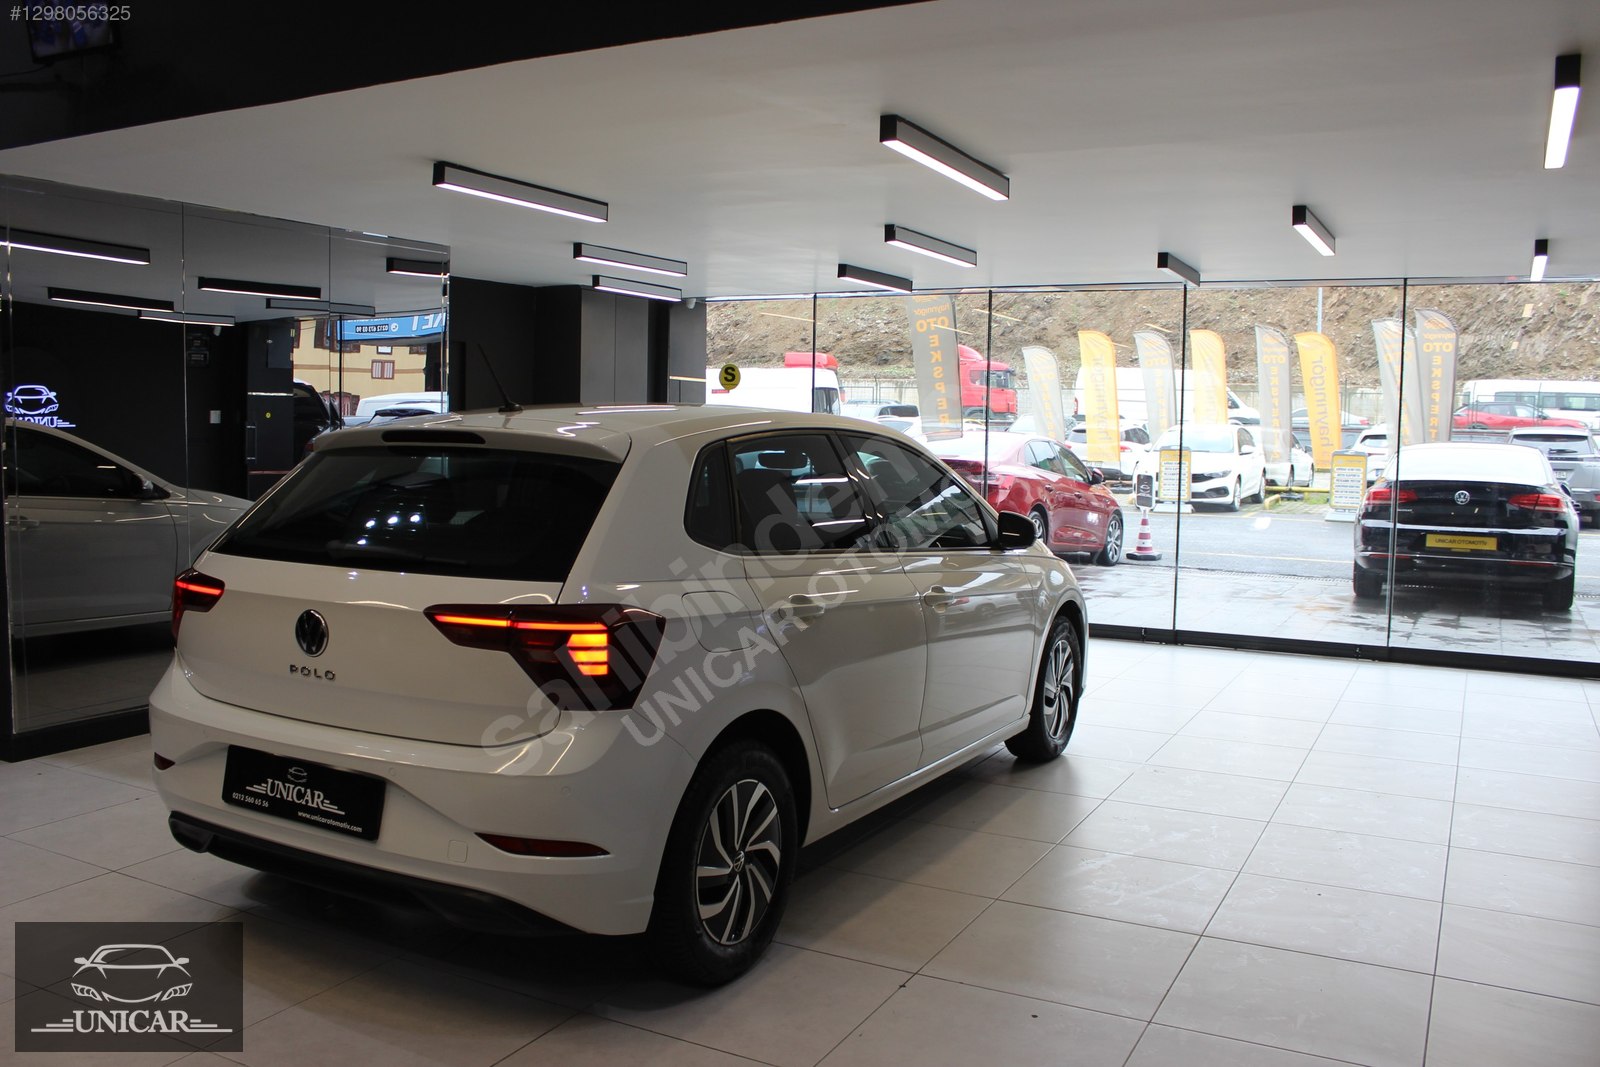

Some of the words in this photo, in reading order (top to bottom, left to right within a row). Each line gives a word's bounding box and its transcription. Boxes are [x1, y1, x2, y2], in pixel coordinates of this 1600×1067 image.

[723, 366, 736, 382] S
[289, 664, 336, 681] POLO
[232, 792, 244, 801] 0212
[266, 778, 325, 807] UNICAR
